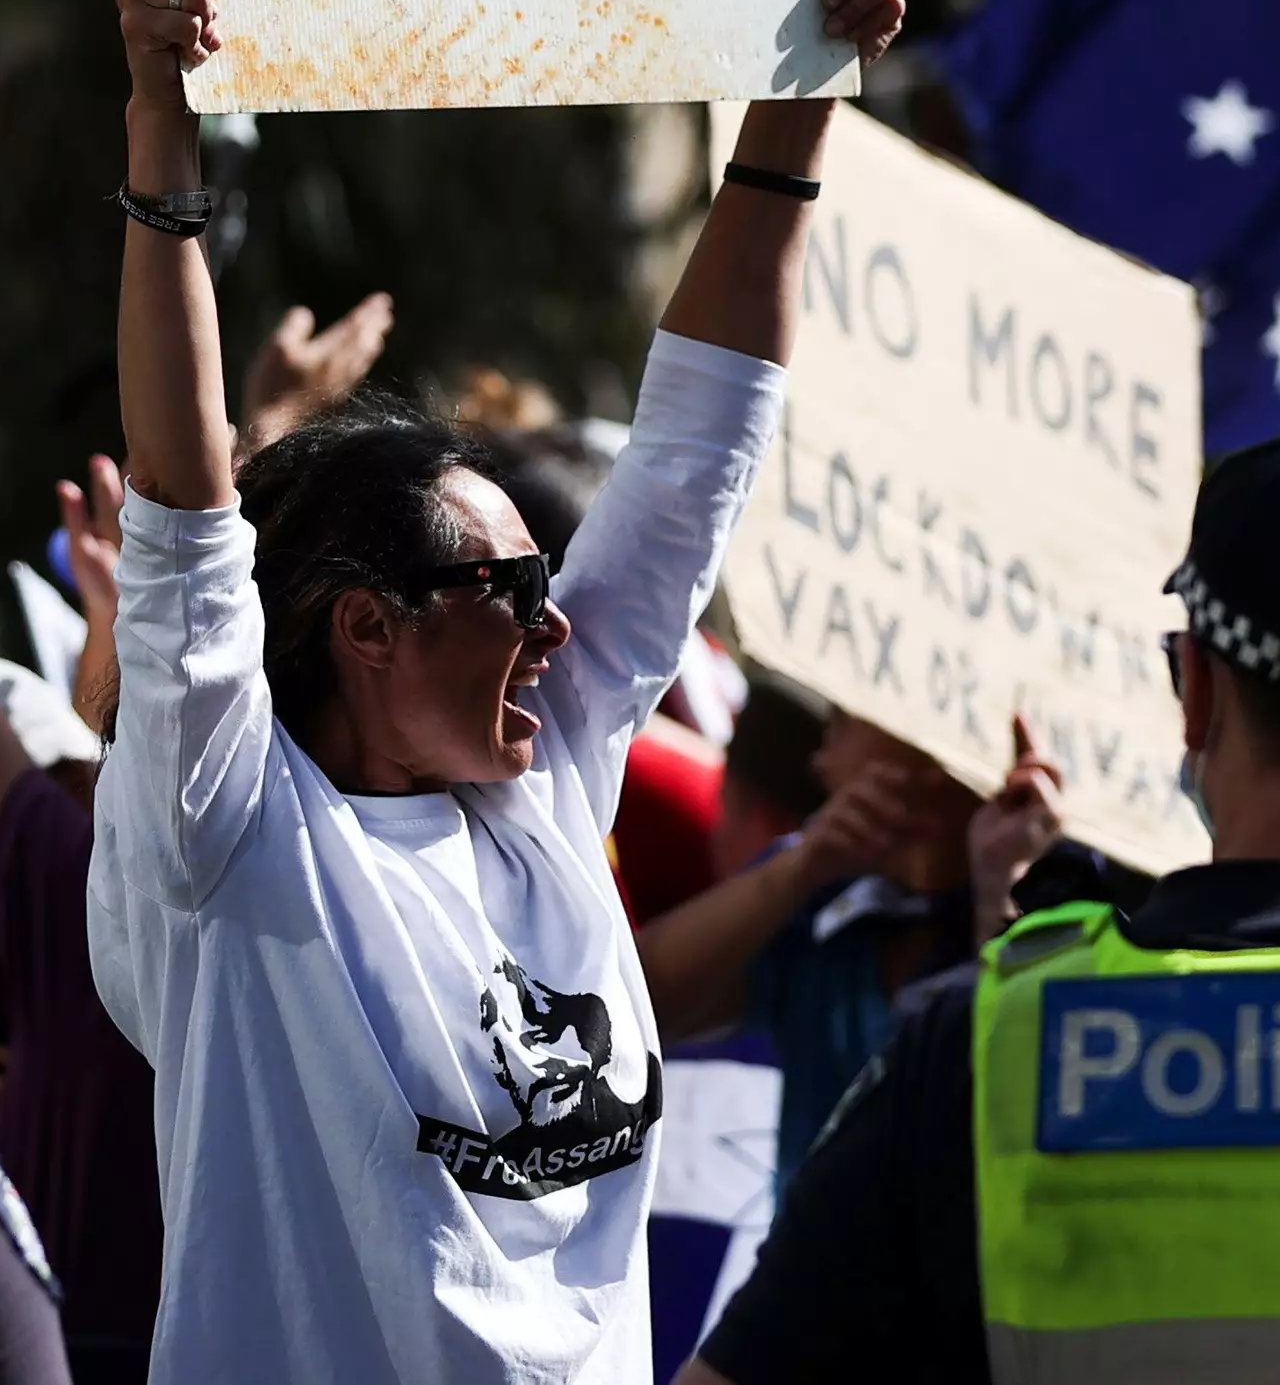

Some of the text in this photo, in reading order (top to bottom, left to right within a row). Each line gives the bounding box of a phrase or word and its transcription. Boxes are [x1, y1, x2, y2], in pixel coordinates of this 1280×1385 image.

[148, 215, 180, 231] FREE
[802, 214, 1161, 501] NO MORE
[764, 542, 906, 698] VAX
[926, 644, 991, 753] OR
